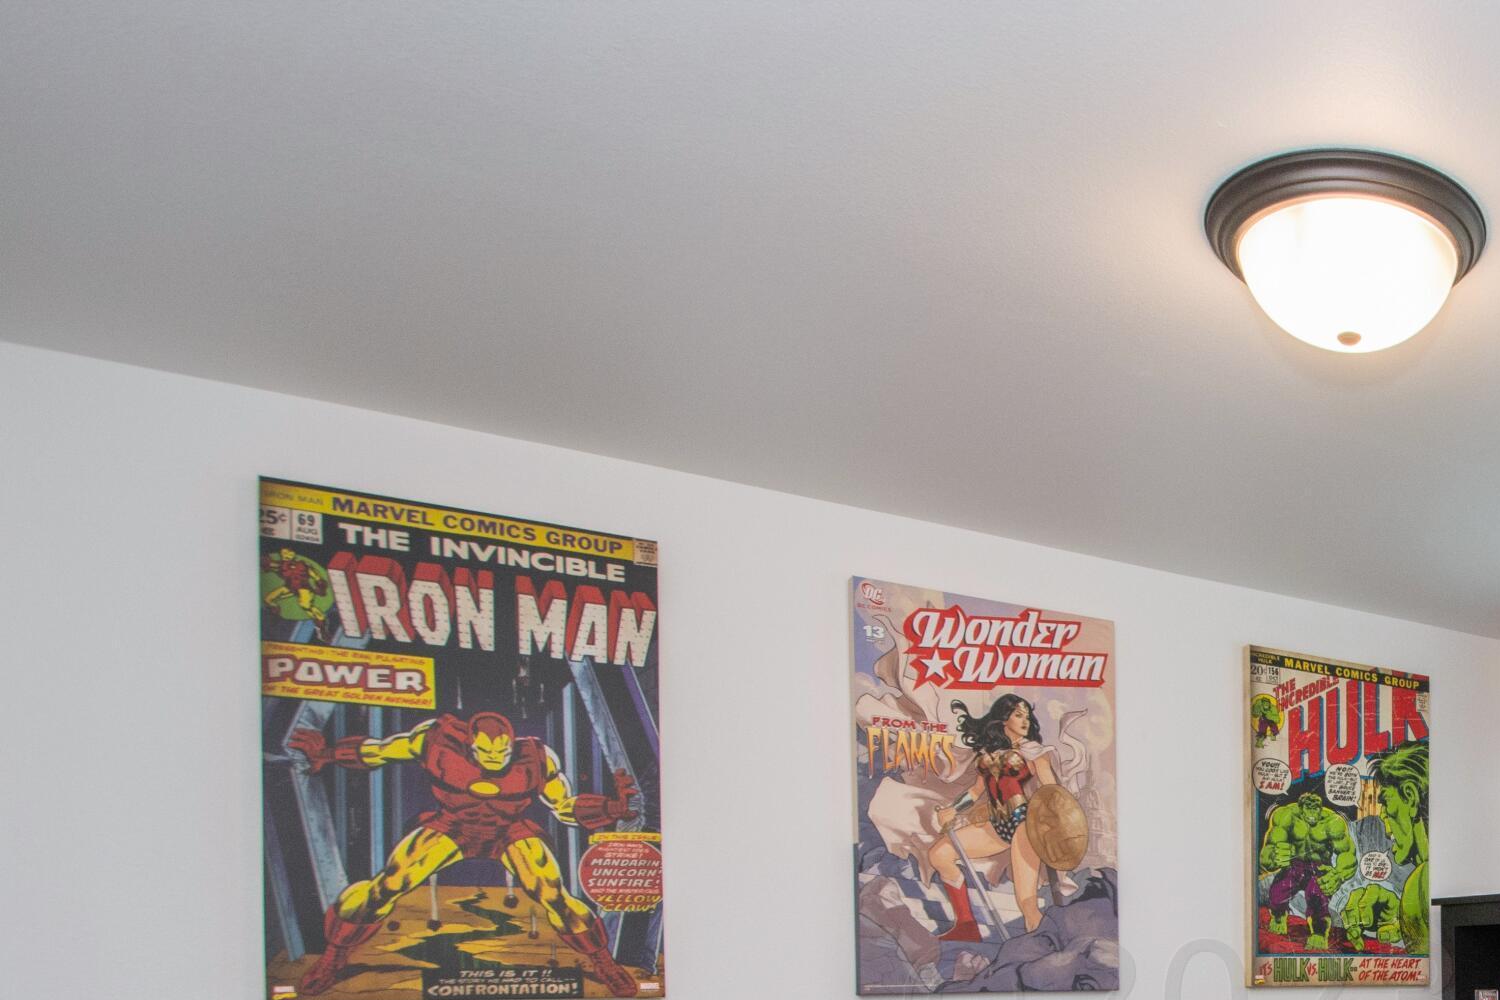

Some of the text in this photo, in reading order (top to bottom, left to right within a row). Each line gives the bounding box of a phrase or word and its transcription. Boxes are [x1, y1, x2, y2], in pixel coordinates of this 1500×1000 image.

[297, 513, 316, 527] 69
[332, 497, 434, 525] MARVEL
[442, 515, 537, 541] COMICS
[546, 531, 623, 554] GROUP
[337, 522, 410, 551] THE
[430, 536, 626, 582] INVINCIBLE
[327, 560, 657, 668] IRON MAN
[863, 625, 884, 639] 13
[912, 609, 1079, 650] Wonder
[265, 657, 425, 692] POWER
[953, 645, 1106, 683] Woman
[1268, 667, 1279, 676] 156
[1284, 657, 1420, 690] MARVEL COMICS GROUP
[303, 688, 341, 698] GREAT
[1272, 677, 1296, 701] THE
[1277, 675, 1340, 711] INCREDIBLE
[872, 716, 948, 733] FROM THE
[1287, 680, 1429, 780] HULK
[866, 727, 957, 782] FLAMES
[588, 878, 660, 888] SUNFIRE!
[596, 894, 661, 902] YELLOW
[460, 970, 495, 978] THIS
[499, 970, 517, 978] IS
[522, 970, 538, 978] IT
[1259, 961, 1273, 977] IT'S
[1273, 958, 1309, 982] HULK
[1358, 970, 1372, 981] OF
[1373, 970, 1390, 981] THE
[1359, 958, 1422, 970] AT THE HEART
[427, 982, 578, 996] CONFRONTATION!
